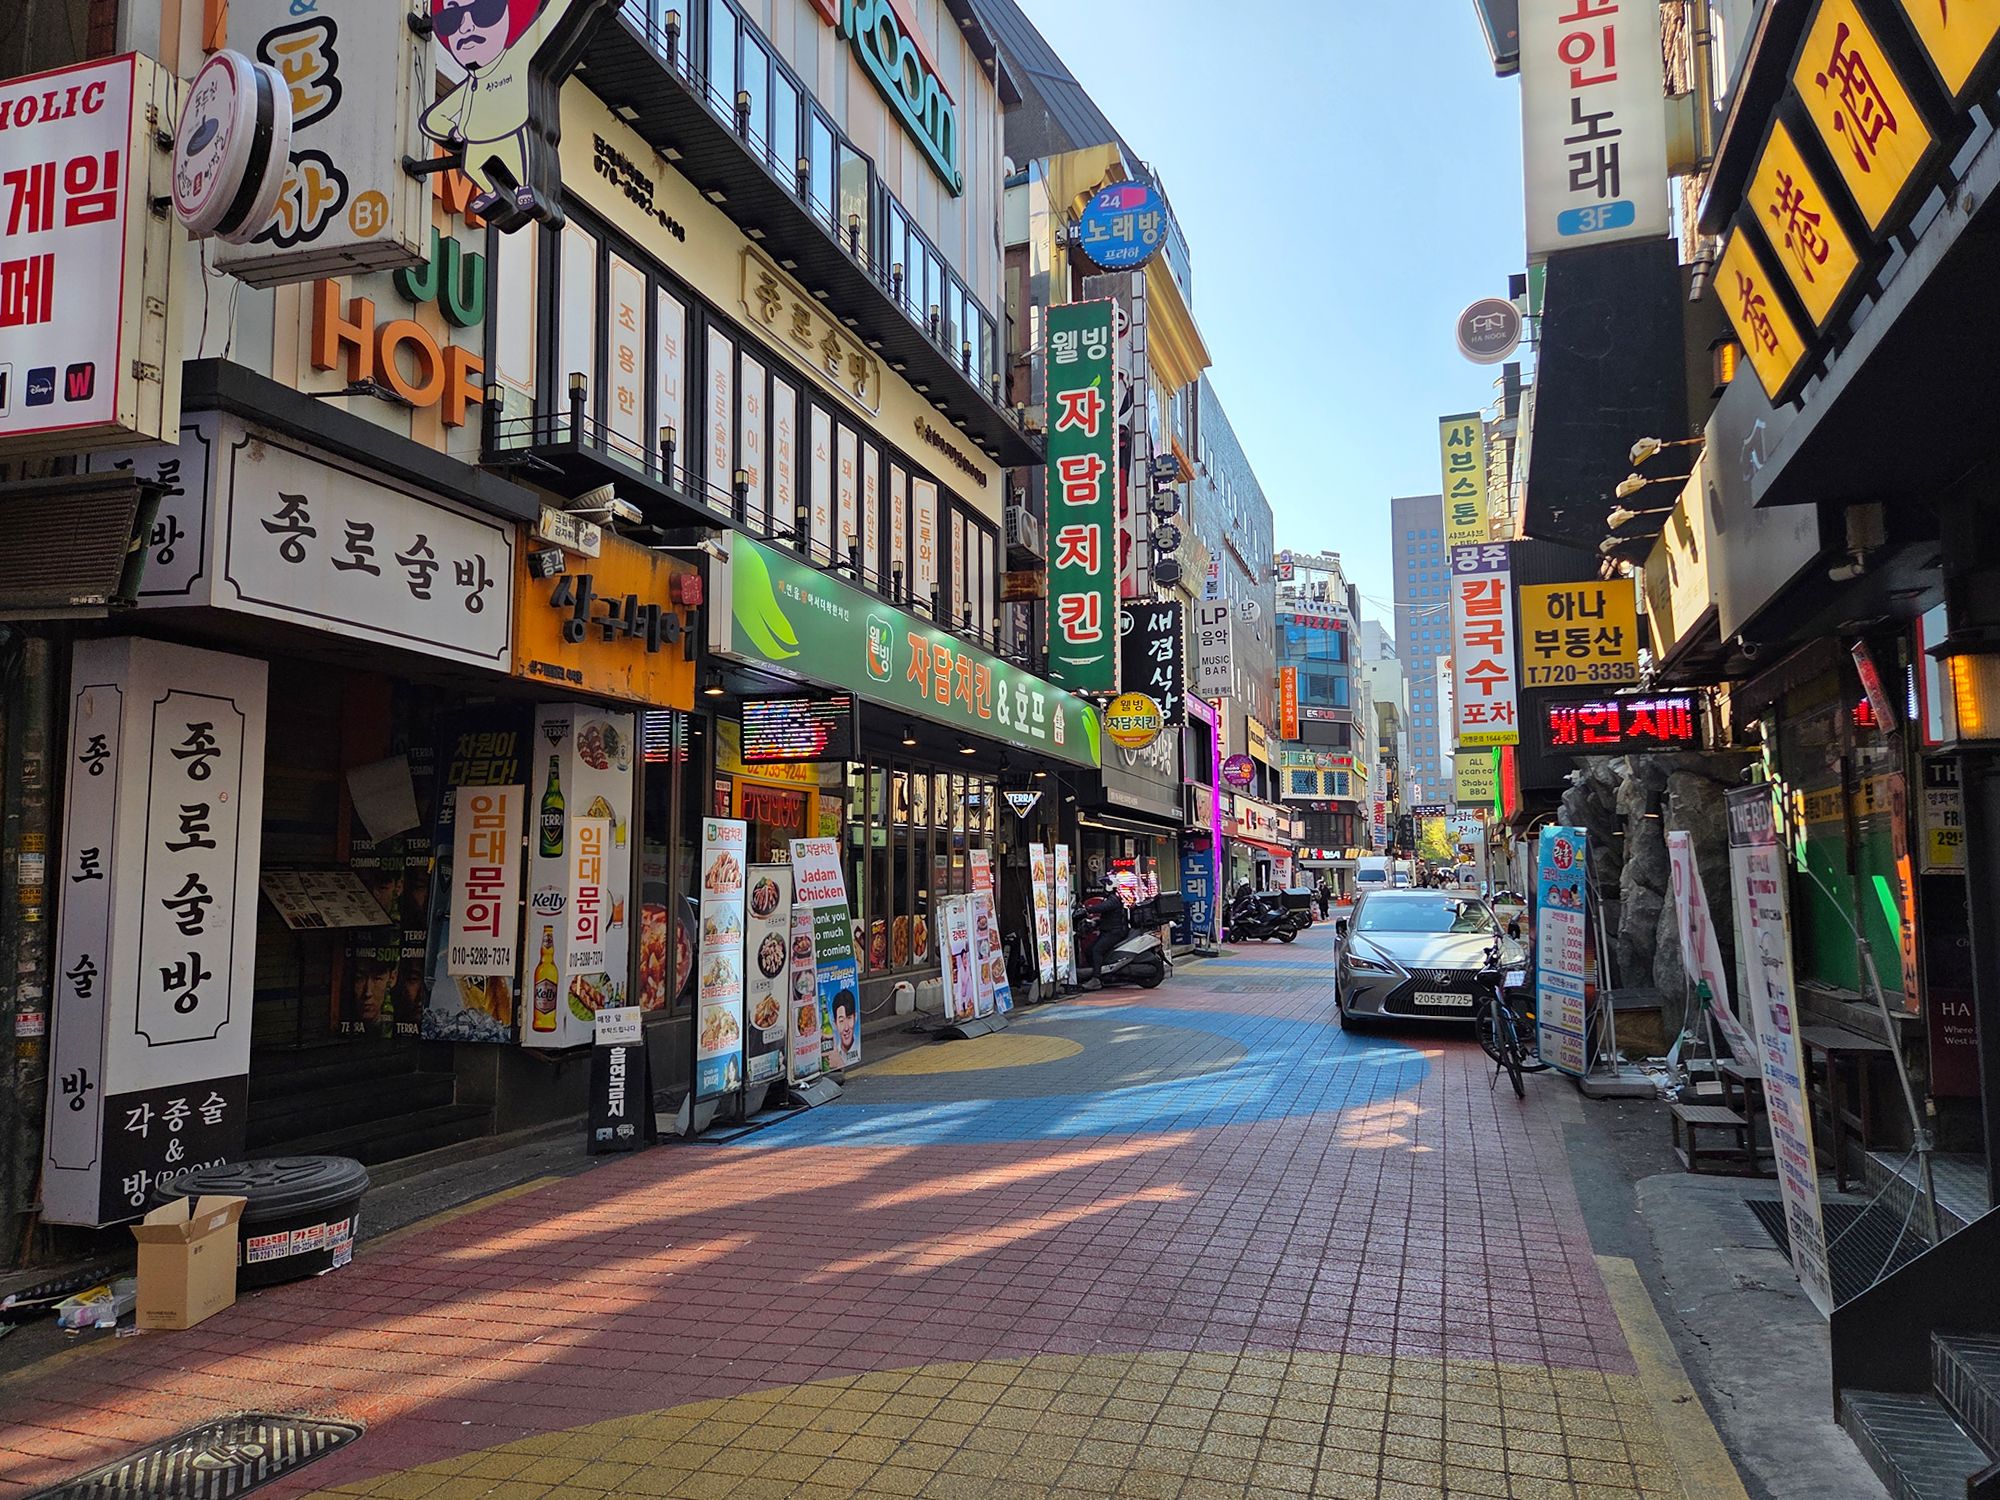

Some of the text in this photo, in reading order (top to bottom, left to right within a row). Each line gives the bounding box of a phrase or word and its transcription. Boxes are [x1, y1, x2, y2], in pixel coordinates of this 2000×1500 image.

[1557, 0, 1623, 199] 인노래
[1100, 194, 1120, 208] 24
[354, 201, 382, 230] B1
[1577, 207, 1612, 232] 3F
[1084, 210, 1161, 245] 노래방
[1103, 246, 1140, 261] 프라하
[754, 271, 870, 398] 종로술방
[312, 278, 485, 427] HOF
[1051, 328, 1108, 365] 웰빙
[618, 303, 636, 416] 조용한
[714, 369, 727, 470] 종로술방
[747, 392, 760, 489] 하이볼
[778, 416, 790, 506] 수제맥주
[816, 441, 827, 527] 소주
[1447, 425, 1479, 526] 샤브스톤
[1151, 455, 1179, 551] 노래방
[1055, 388, 1106, 644] 자담치킨
[260, 490, 494, 614] 종로술방
[1455, 546, 1507, 572] 공주
[1241, 602, 1255, 612] LP
[1295, 600, 1341, 616] HOTEL
[1547, 590, 1606, 621] 하나
[1201, 607, 1228, 625] LP
[1295, 614, 1342, 630] PIZZA
[1201, 629, 1228, 647] 음악
[1460, 578, 1510, 697] 칼국수
[1534, 626, 1623, 660] 부동산
[869, 626, 891, 673] 웰빙
[1147, 609, 1179, 720] 새겹식당
[1202, 655, 1230, 665] MUSIC
[1205, 665, 1227, 676] BAR
[1527, 662, 1636, 684] T.720-3335
[906, 631, 992, 720] 자담치킨
[997, 679, 1010, 726] &
[1014, 683, 1046, 740] 호프
[1119, 699, 1144, 712] 웰빙
[1318, 709, 1336, 720] PUB
[1462, 700, 1516, 725] 포차
[543, 725, 569, 738] TERRA
[1106, 715, 1157, 731] 자담치킨
[456, 732, 518, 758] 차원이
[1298, 754, 1314, 763] 코인
[1469, 757, 1485, 766] ALL
[447, 759, 519, 787] 다르다!
[1467, 768, 1483, 776] can
[1931, 764, 1959, 783] TH
[1461, 778, 1486, 787] Shabu
[1469, 787, 1487, 797] BBQ
[1008, 793, 1034, 803] TERRA
[540, 814, 564, 827] TERRA
[1943, 810, 1963, 828] FR
[717, 824, 743, 842] 자담치킨
[806, 841, 834, 857] 자담치킨
[1183, 840, 1195, 850] 24
[155, 720, 222, 1015] 종로술방
[350, 857, 381, 869] COMING
[463, 794, 507, 938] 임대문의
[575, 827, 601, 945] 임대문의
[801, 869, 837, 885] Jadam
[532, 892, 567, 912] Kelly
[798, 886, 845, 903] Chicken
[61, 732, 111, 1114] 종로술방
[831, 913, 846, 926] you
[822, 928, 844, 940] much
[345, 947, 377, 959] CMING
[452, 946, 511, 967] 010-5288-7374
[822, 944, 851, 957] coming
[341, 1021, 366, 1034] TERA
[396, 1022, 420, 1035] TERRA
[1943, 1025, 1974, 1035] Where
[1944, 1036, 1967, 1046] West
[608, 1047, 627, 1118] 흡연금지
[124, 1091, 227, 1139] 각종술
[165, 1138, 184, 1163] &
